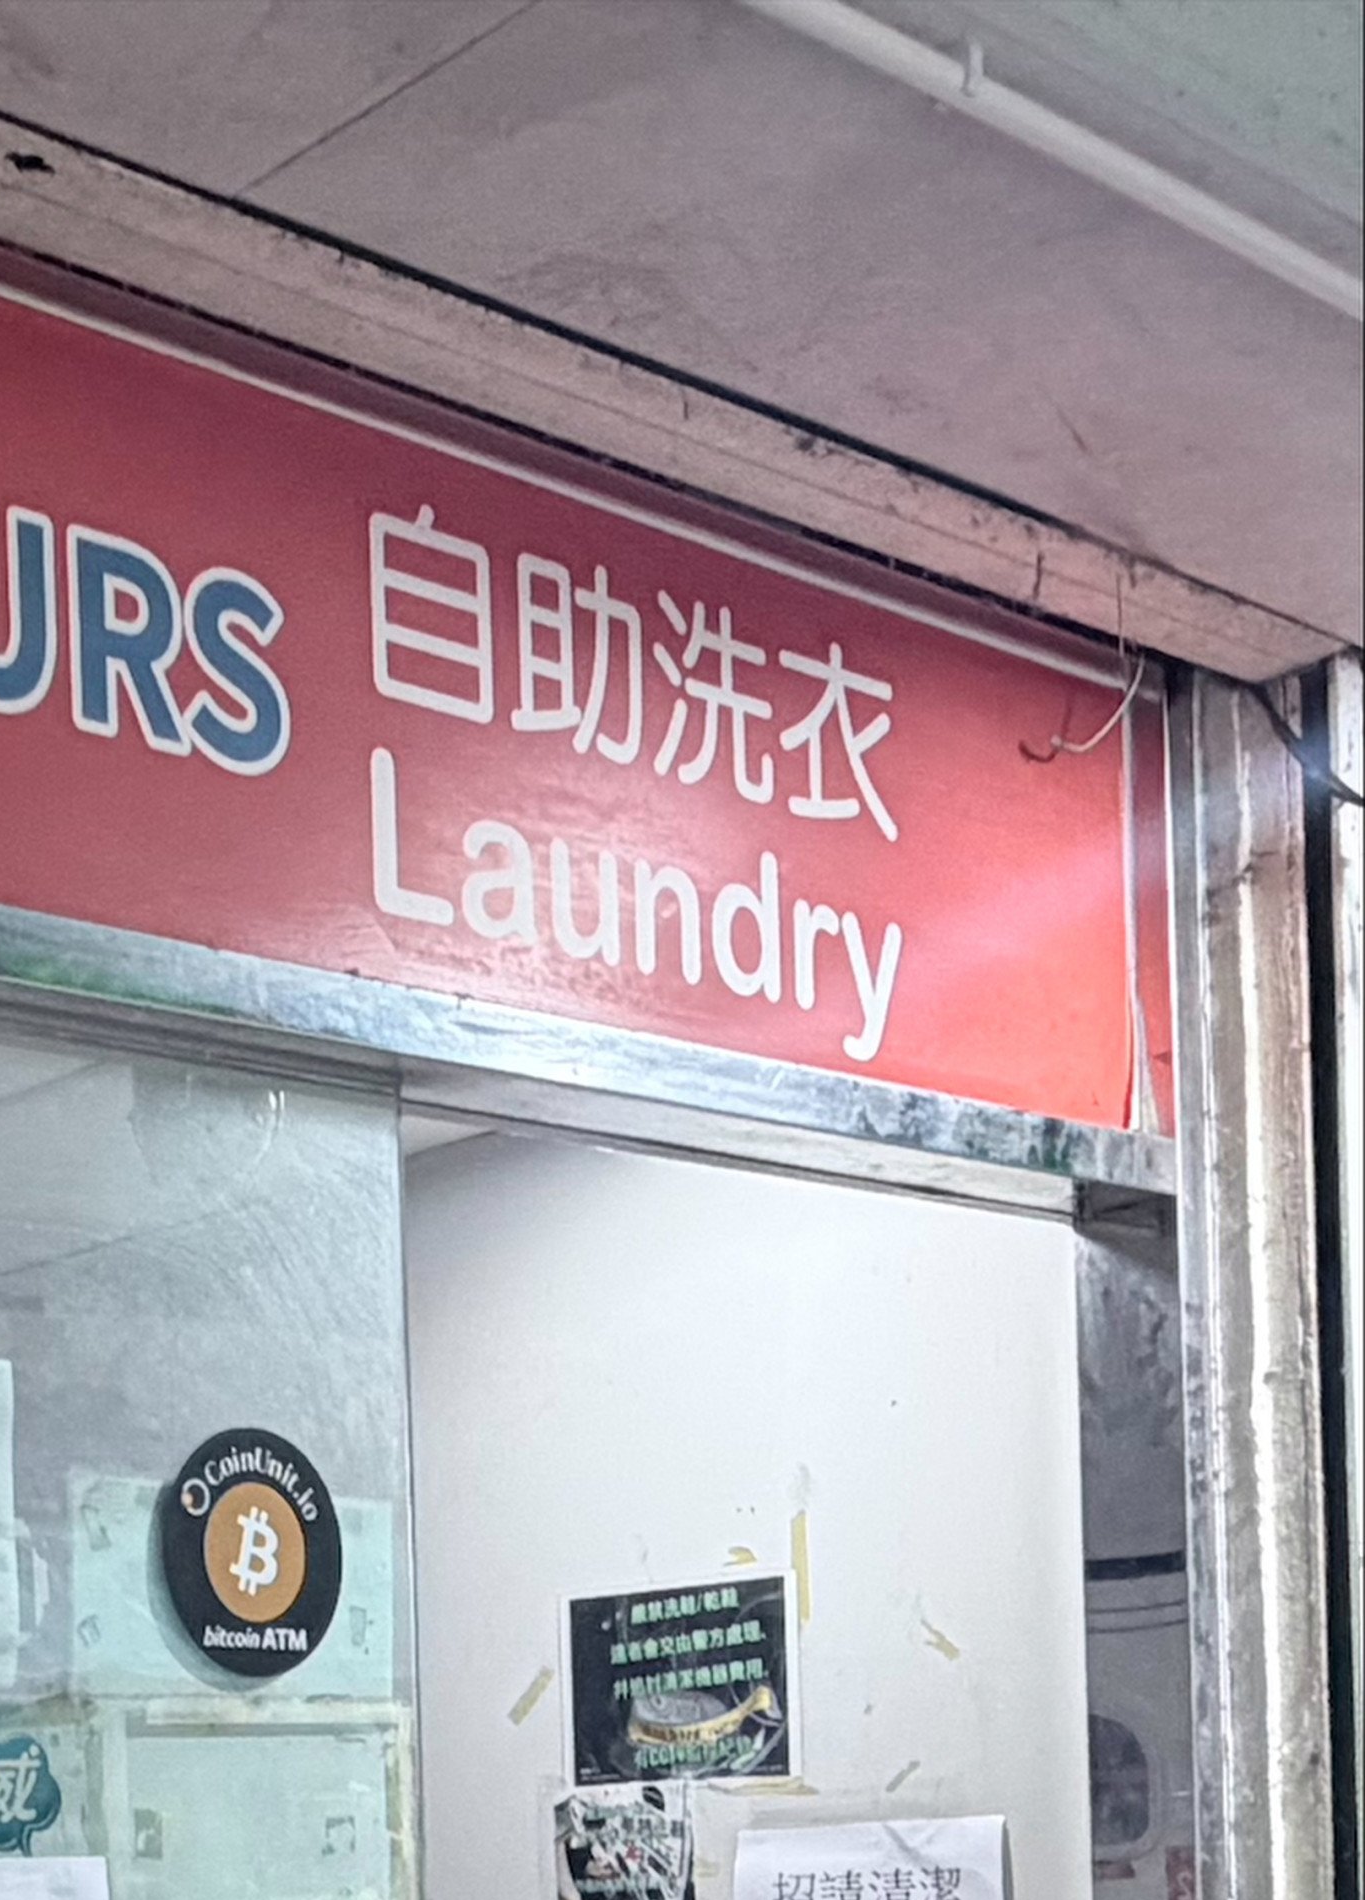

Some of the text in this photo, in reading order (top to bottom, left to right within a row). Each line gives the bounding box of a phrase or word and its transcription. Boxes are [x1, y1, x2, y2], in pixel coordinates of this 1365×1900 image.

[369, 505, 898, 842] 自助洗衣
[369, 747, 903, 1061] Laundry
[203, 1445, 319, 1522] CoinUnit.io
[202, 1625, 308, 1652] bitcoin ATM
